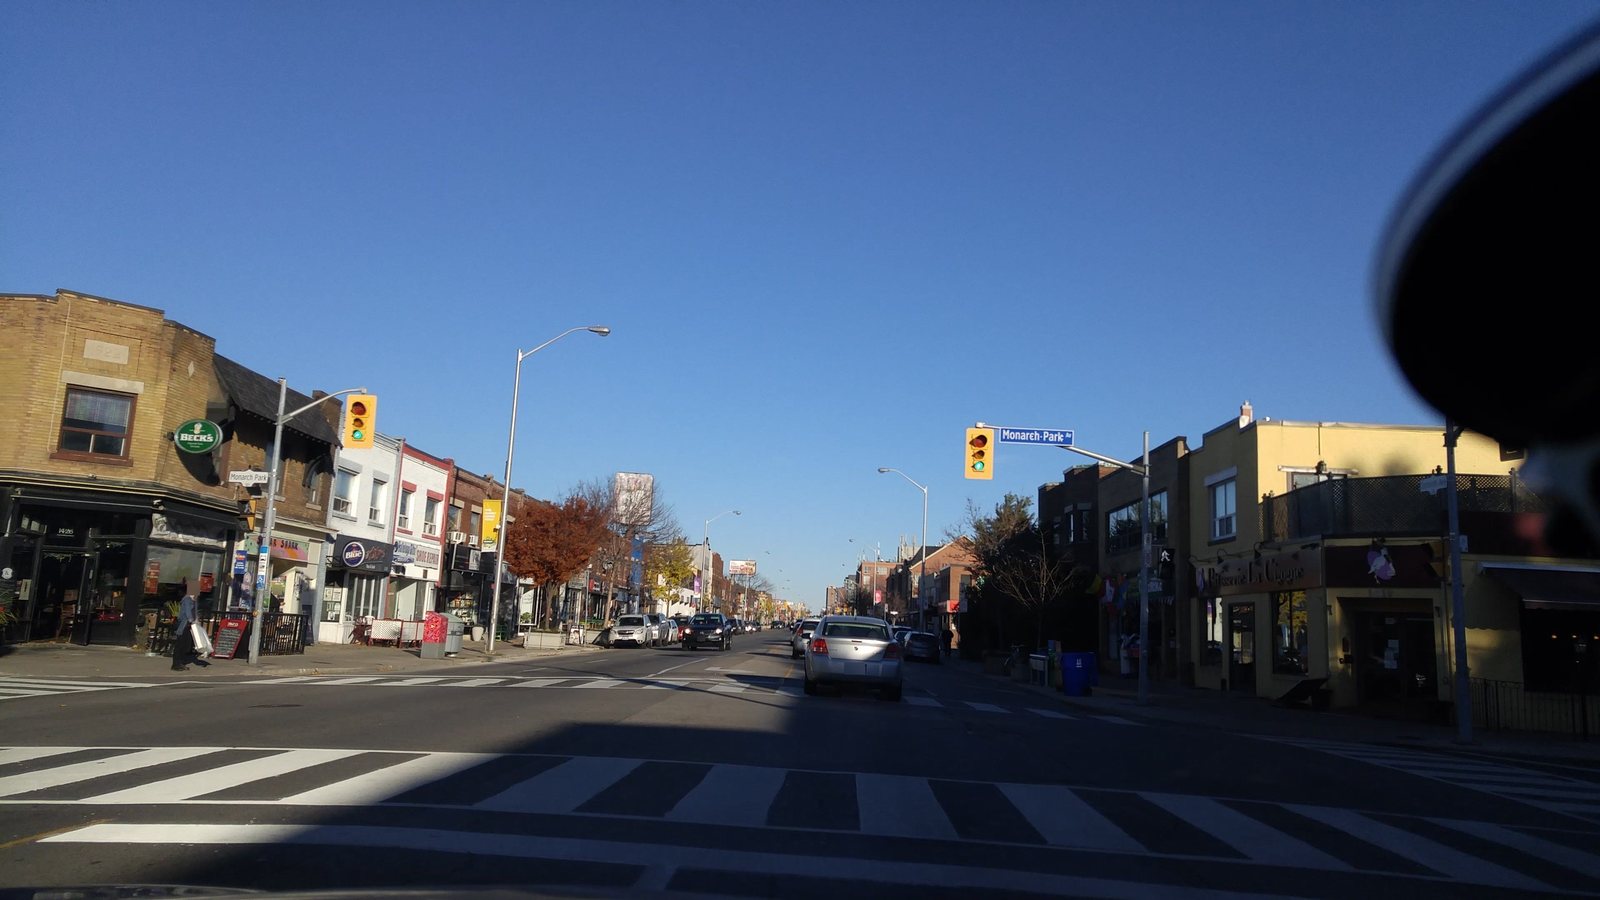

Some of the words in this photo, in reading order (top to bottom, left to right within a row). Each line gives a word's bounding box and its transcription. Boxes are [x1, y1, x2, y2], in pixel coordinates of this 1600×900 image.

[1002, 430, 1040, 441] Monarch
[1043, 431, 1064, 442] Park
[231, 473, 254, 481] Monarch
